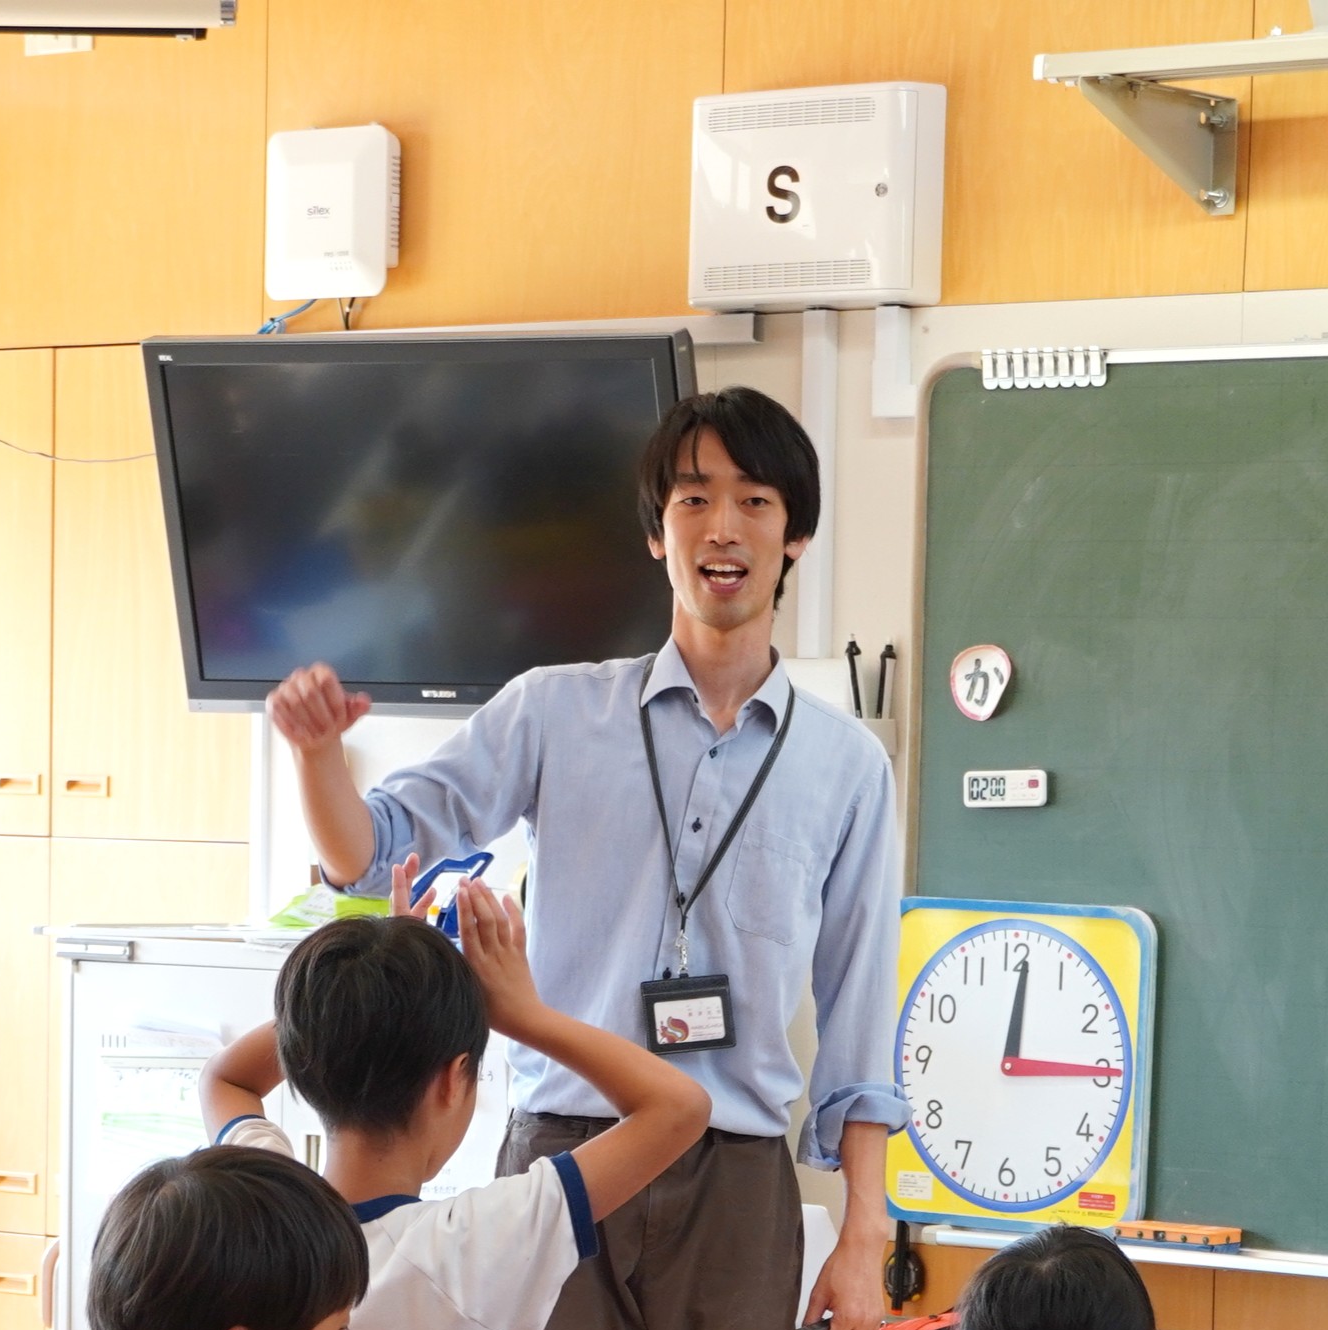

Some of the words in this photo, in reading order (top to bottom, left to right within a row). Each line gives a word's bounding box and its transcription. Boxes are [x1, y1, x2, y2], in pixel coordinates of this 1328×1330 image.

[765, 165, 801, 224] S
[307, 205, 330, 216] silex
[964, 658, 1005, 706] か
[963, 956, 985, 986] 11
[1004, 942, 1030, 973] 12
[1058, 961, 1064, 991] 1
[930, 993, 956, 1024] 10
[1081, 1003, 1100, 1034] 2
[914, 1044, 933, 1075] 9
[1092, 1058, 1111, 1088] 3
[925, 1099, 943, 1130] 8
[1076, 1112, 1094, 1143] 4
[954, 1140, 972, 1170] 7
[1044, 1146, 1062, 1177] 5
[998, 1157, 1016, 1187] 6
